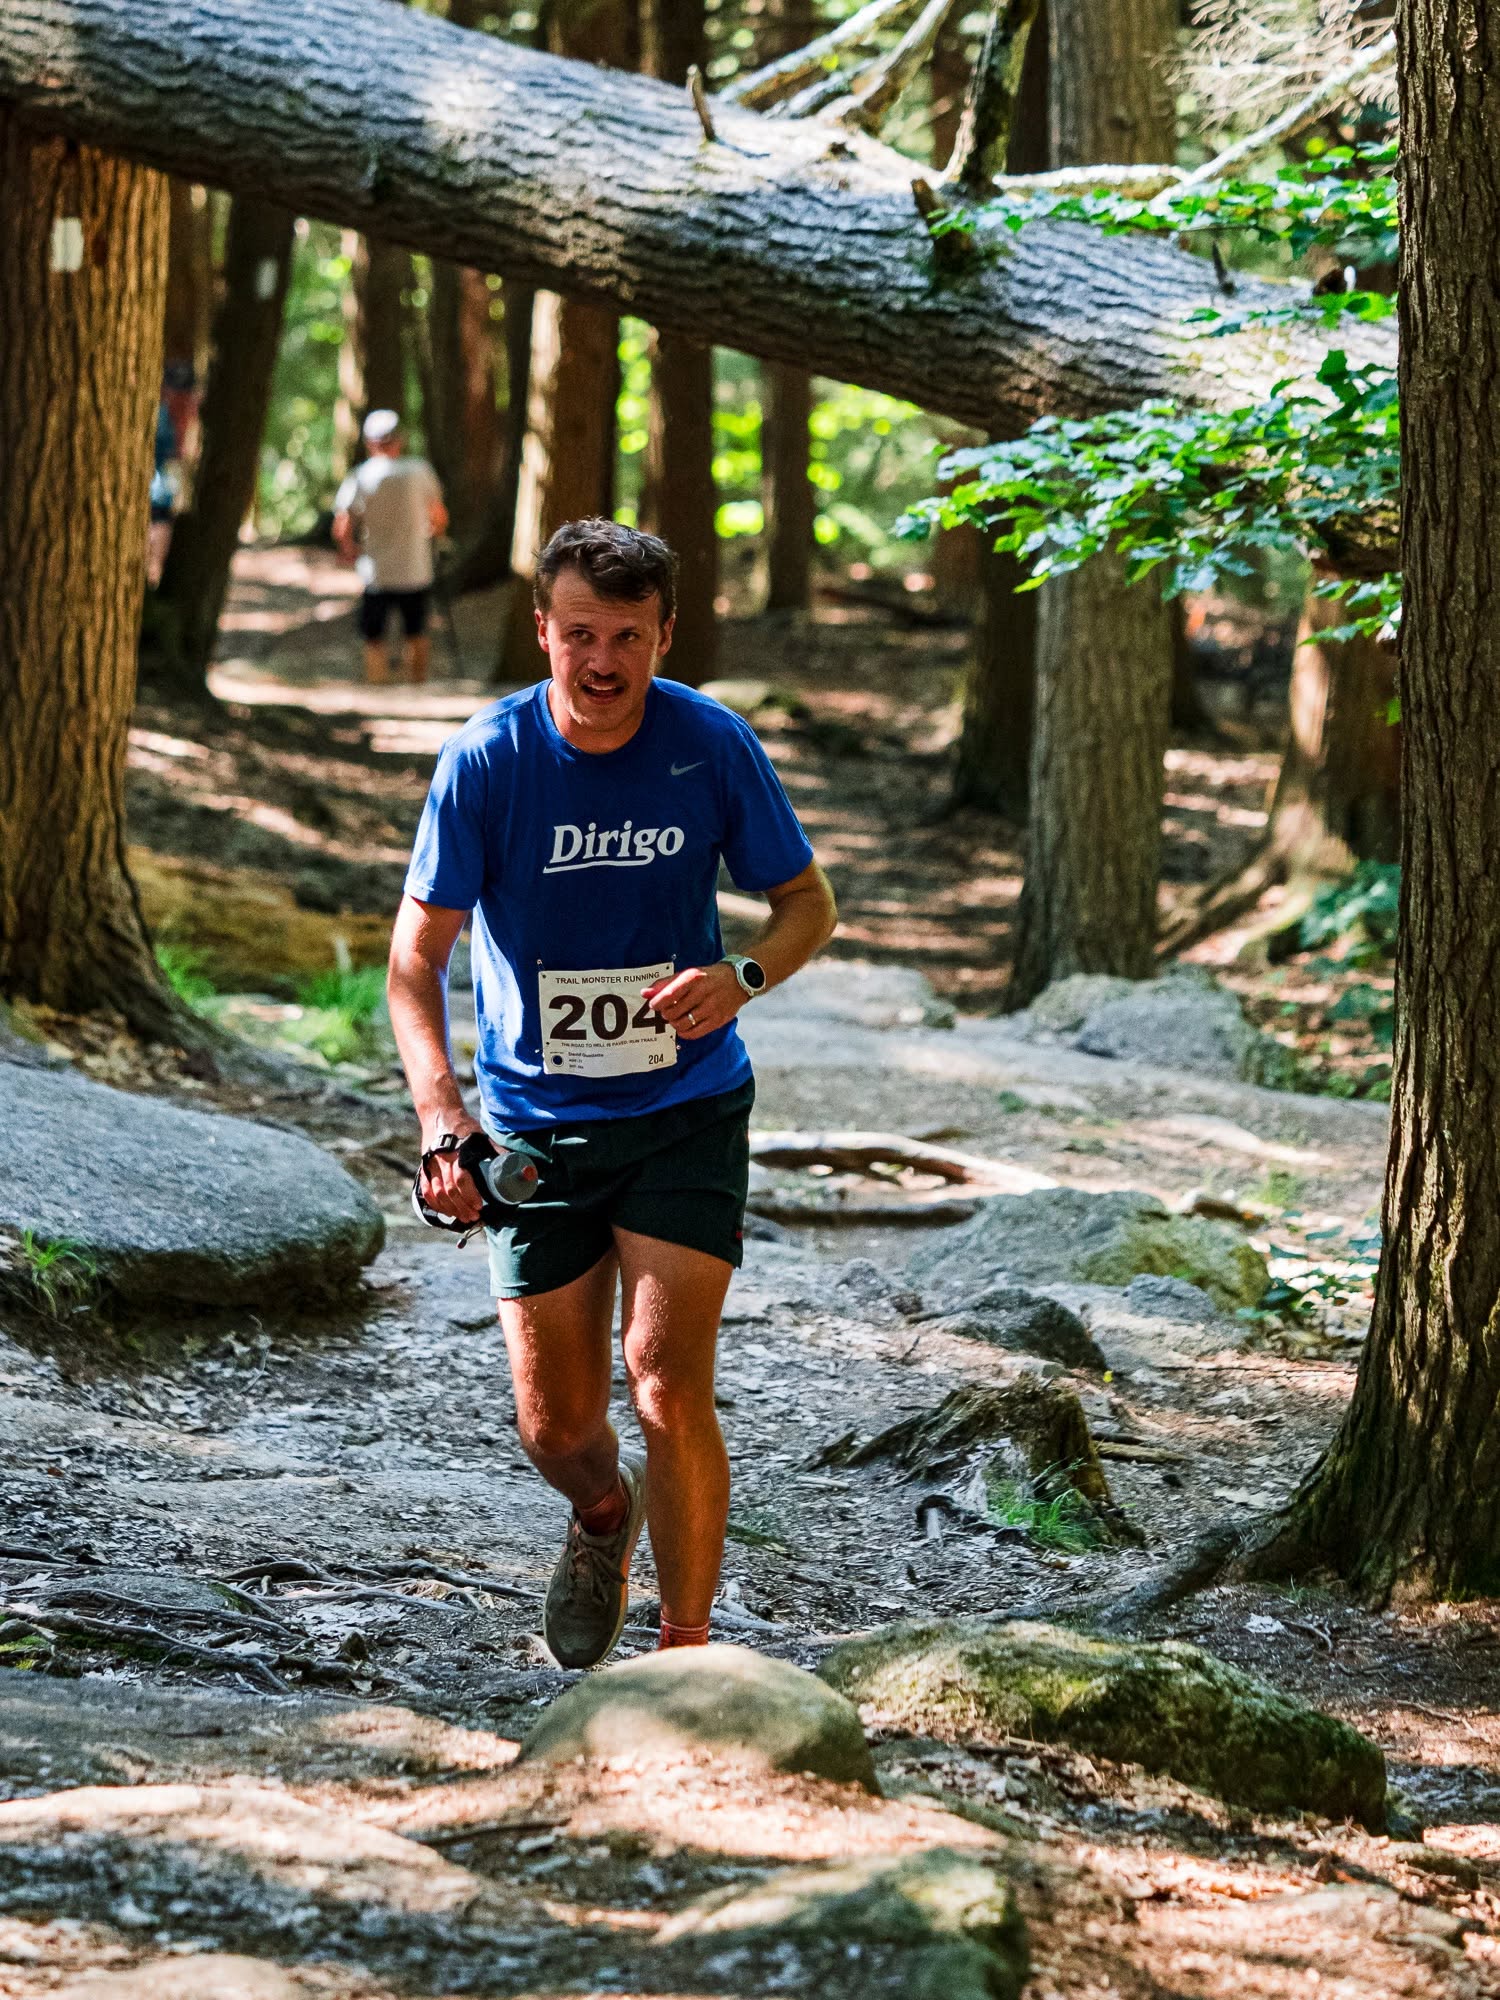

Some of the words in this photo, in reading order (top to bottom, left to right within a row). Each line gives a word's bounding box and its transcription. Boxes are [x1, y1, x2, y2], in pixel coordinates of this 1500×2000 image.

[543, 820, 685, 874] Dirigo
[555, 977, 580, 985] TRAIL
[581, 976, 622, 984] MONSTER
[623, 971, 660, 983] RUNNING
[548, 993, 669, 1041] 204
[648, 1053, 664, 1065] 204
